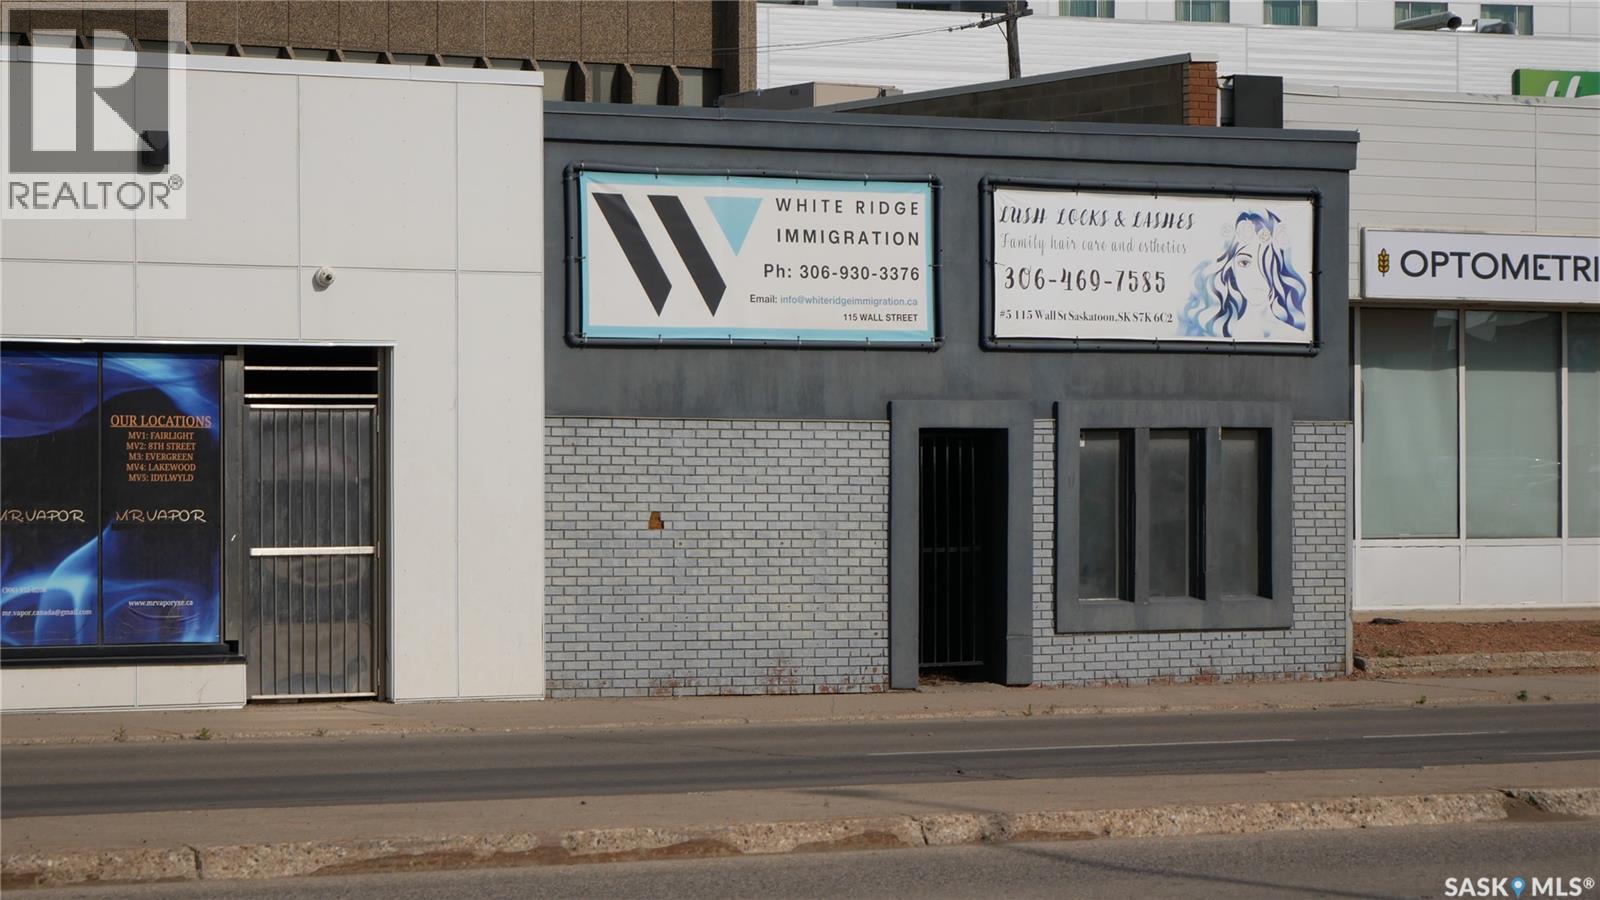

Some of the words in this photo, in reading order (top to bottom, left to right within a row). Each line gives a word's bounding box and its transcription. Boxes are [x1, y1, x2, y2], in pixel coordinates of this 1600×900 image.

[775, 197, 844, 214] WHITE
[855, 200, 919, 216] RIDGE
[999, 205, 1046, 225] LUSH
[1055, 207, 1110, 228] LOCKS
[1113, 210, 1127, 228] &
[1131, 211, 1195, 231] LASHES
[776, 228, 919, 247] IMMIGRATION
[1000, 232, 1046, 256] Family
[1050, 234, 1077, 251] hair
[1081, 238, 1106, 252] care
[1110, 238, 1135, 254] and
[1138, 237, 1188, 255] esthetics
[763, 263, 793, 279] Ph:
[799, 264, 920, 281] 306-930-3376
[1400, 249, 1600, 282] OPTOMETRI
[1004, 265, 1167, 294] 306-469-7585
[749, 294, 778, 304] Email:
[780, 294, 918, 308] info@whiteridgeimmigration.ca
[843, 313, 858, 322] 115
[859, 313, 884, 323] WALL
[885, 313, 918, 323] STREET
[999, 309, 1012, 320] #5
[1015, 309, 1033, 321] 115
[1035, 309, 1056, 321] Wall
[1057, 311, 1068, 321] St
[1132, 312, 1153, 323] S7K
[1153, 313, 1173, 324] 6C2
[110, 414, 138, 428] OUR
[140, 415, 212, 428] LOCATIONS
[128, 431, 149, 440] MV1:
[150, 431, 195, 440] FAIRLIGHT
[126, 442, 147, 451] MV2:
[148, 442, 165, 450] 8TH
[166, 442, 197, 451] STREET
[128, 452, 144, 461] M3:
[145, 452, 194, 461] EVERGREEN
[126, 463, 147, 472] MV4:
[148, 463, 197, 472] LAKEWOOD
[128, 474, 149, 482] MV5:
[150, 474, 194, 482] IDYLWYLD
